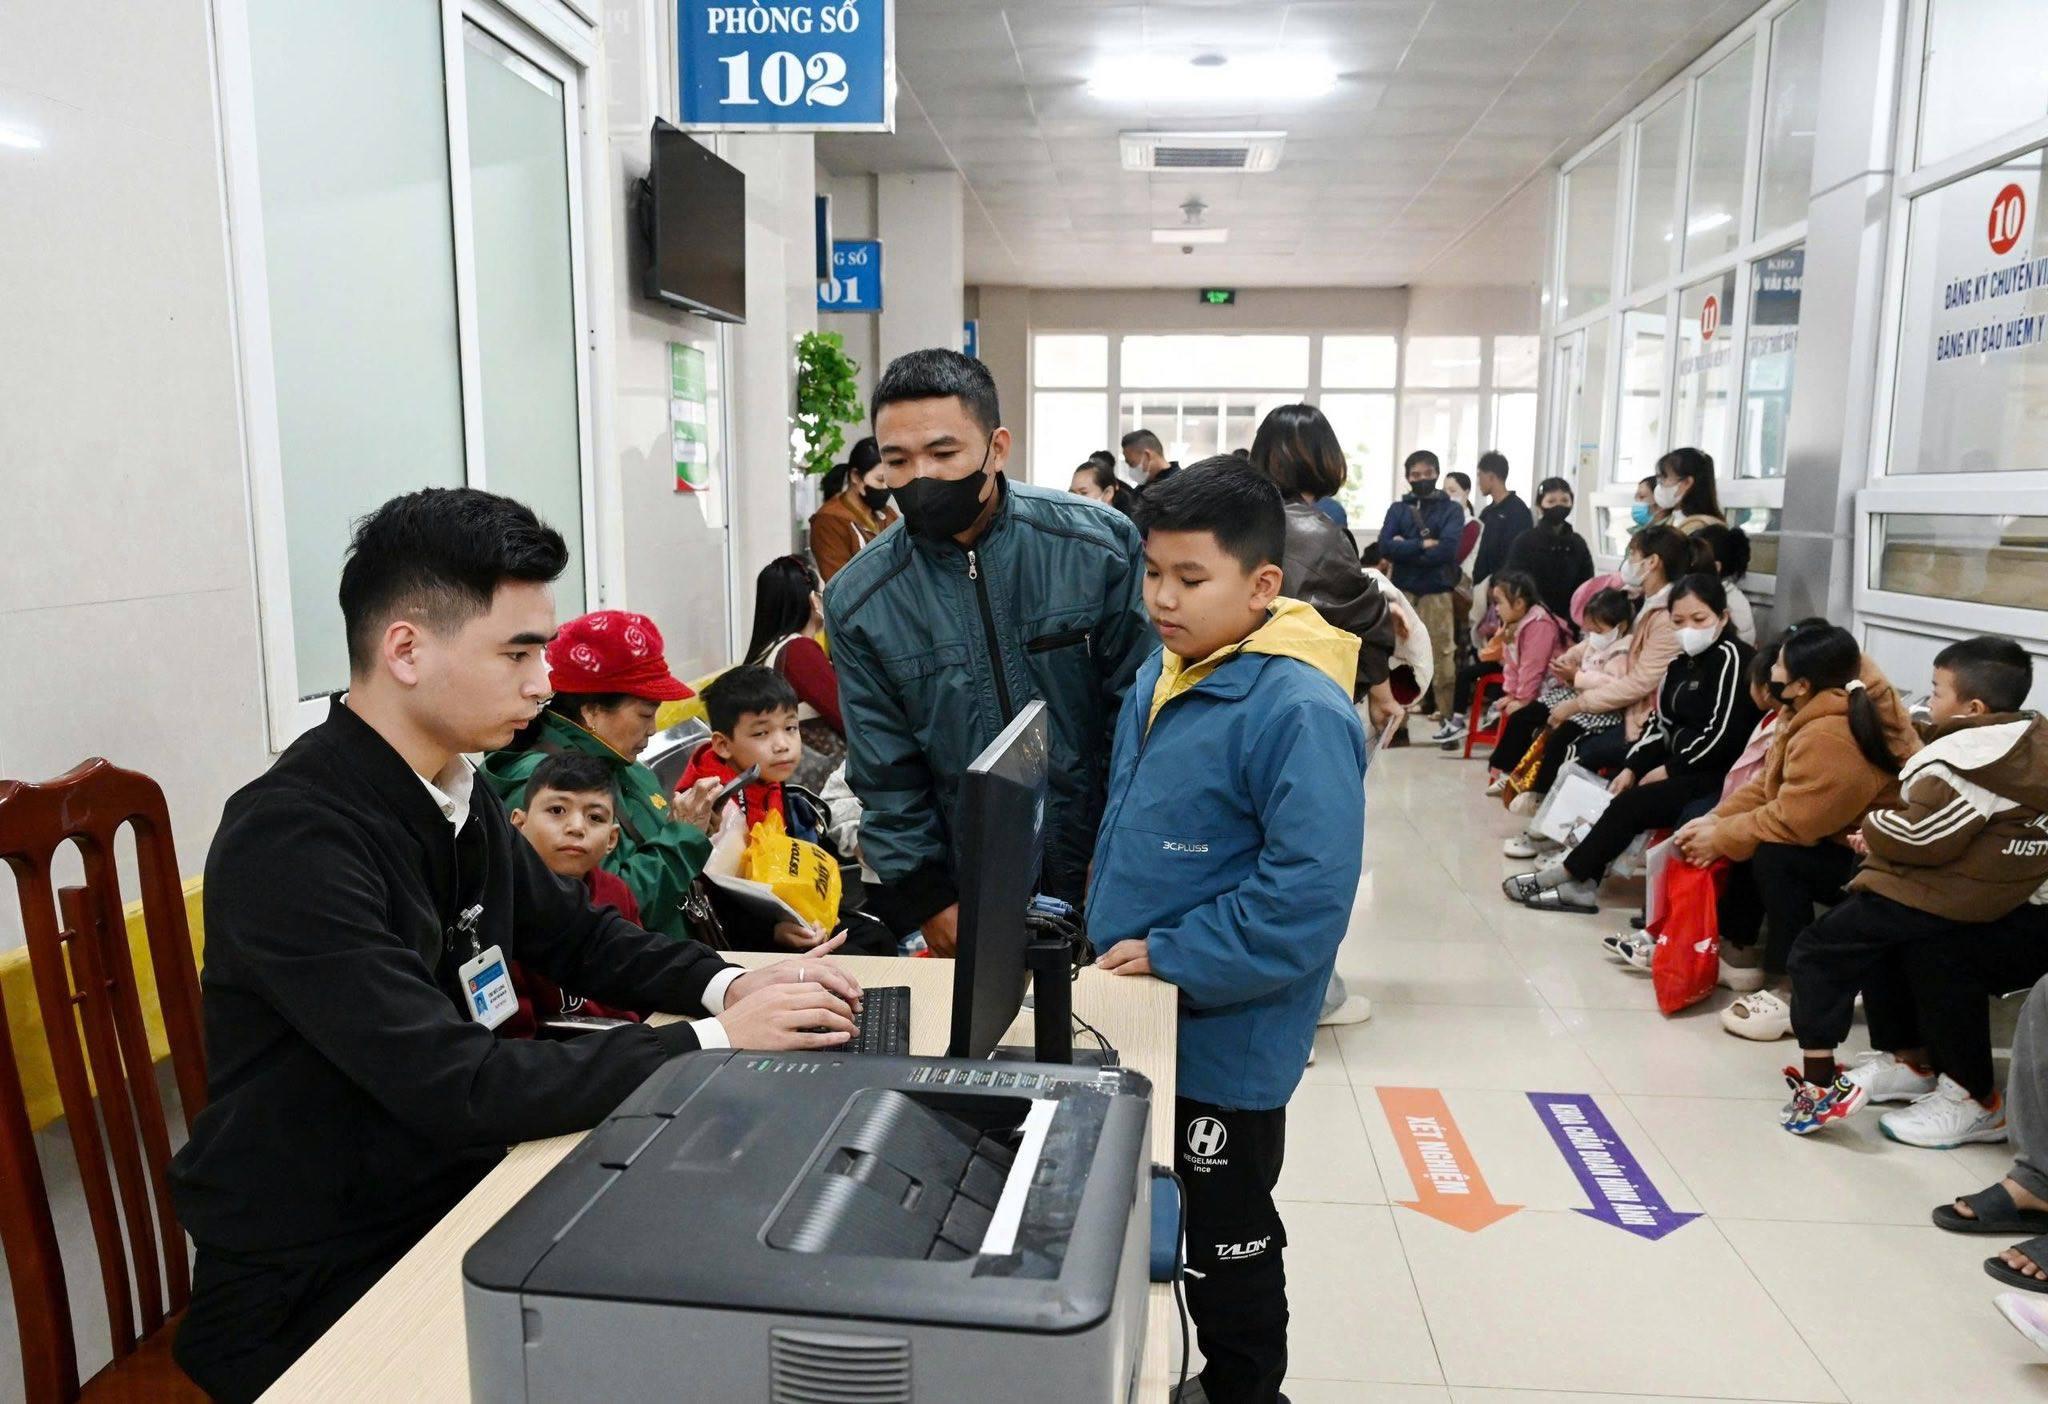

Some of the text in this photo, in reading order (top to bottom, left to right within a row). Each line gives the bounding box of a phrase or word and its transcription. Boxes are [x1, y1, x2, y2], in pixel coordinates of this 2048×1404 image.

[708, 0, 859, 34] PHÒNG SỐ
[718, 51, 849, 107] 102
[1991, 195, 2022, 243] 10
[847, 246, 867, 265] SỐ
[818, 276, 862, 303] 01
[1703, 304, 1716, 333] 11
[1405, 1116, 1471, 1195] XÉT NGHIỆM
